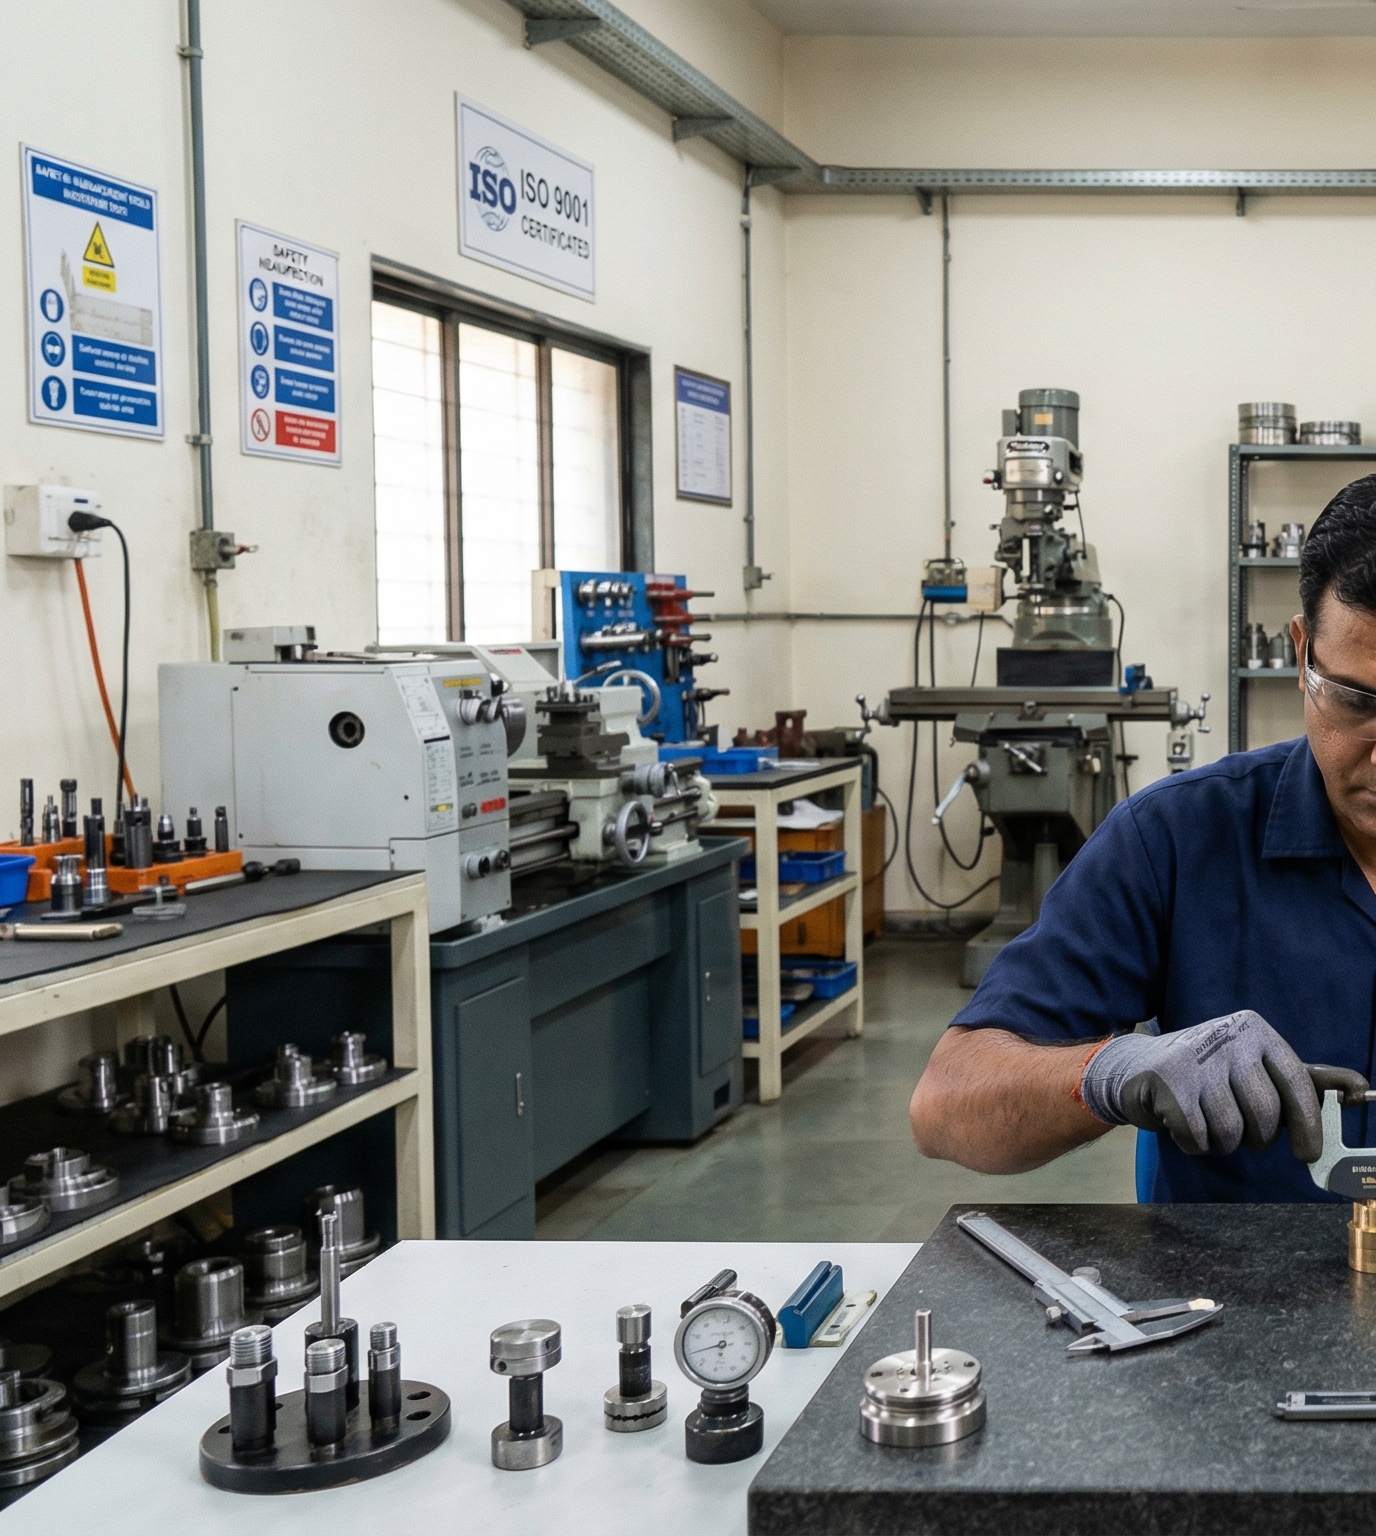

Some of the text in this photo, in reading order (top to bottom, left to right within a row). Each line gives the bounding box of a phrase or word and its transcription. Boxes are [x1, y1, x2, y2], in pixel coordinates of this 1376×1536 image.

[469, 161, 516, 214] ISO
[520, 168, 589, 228] ISO 9001
